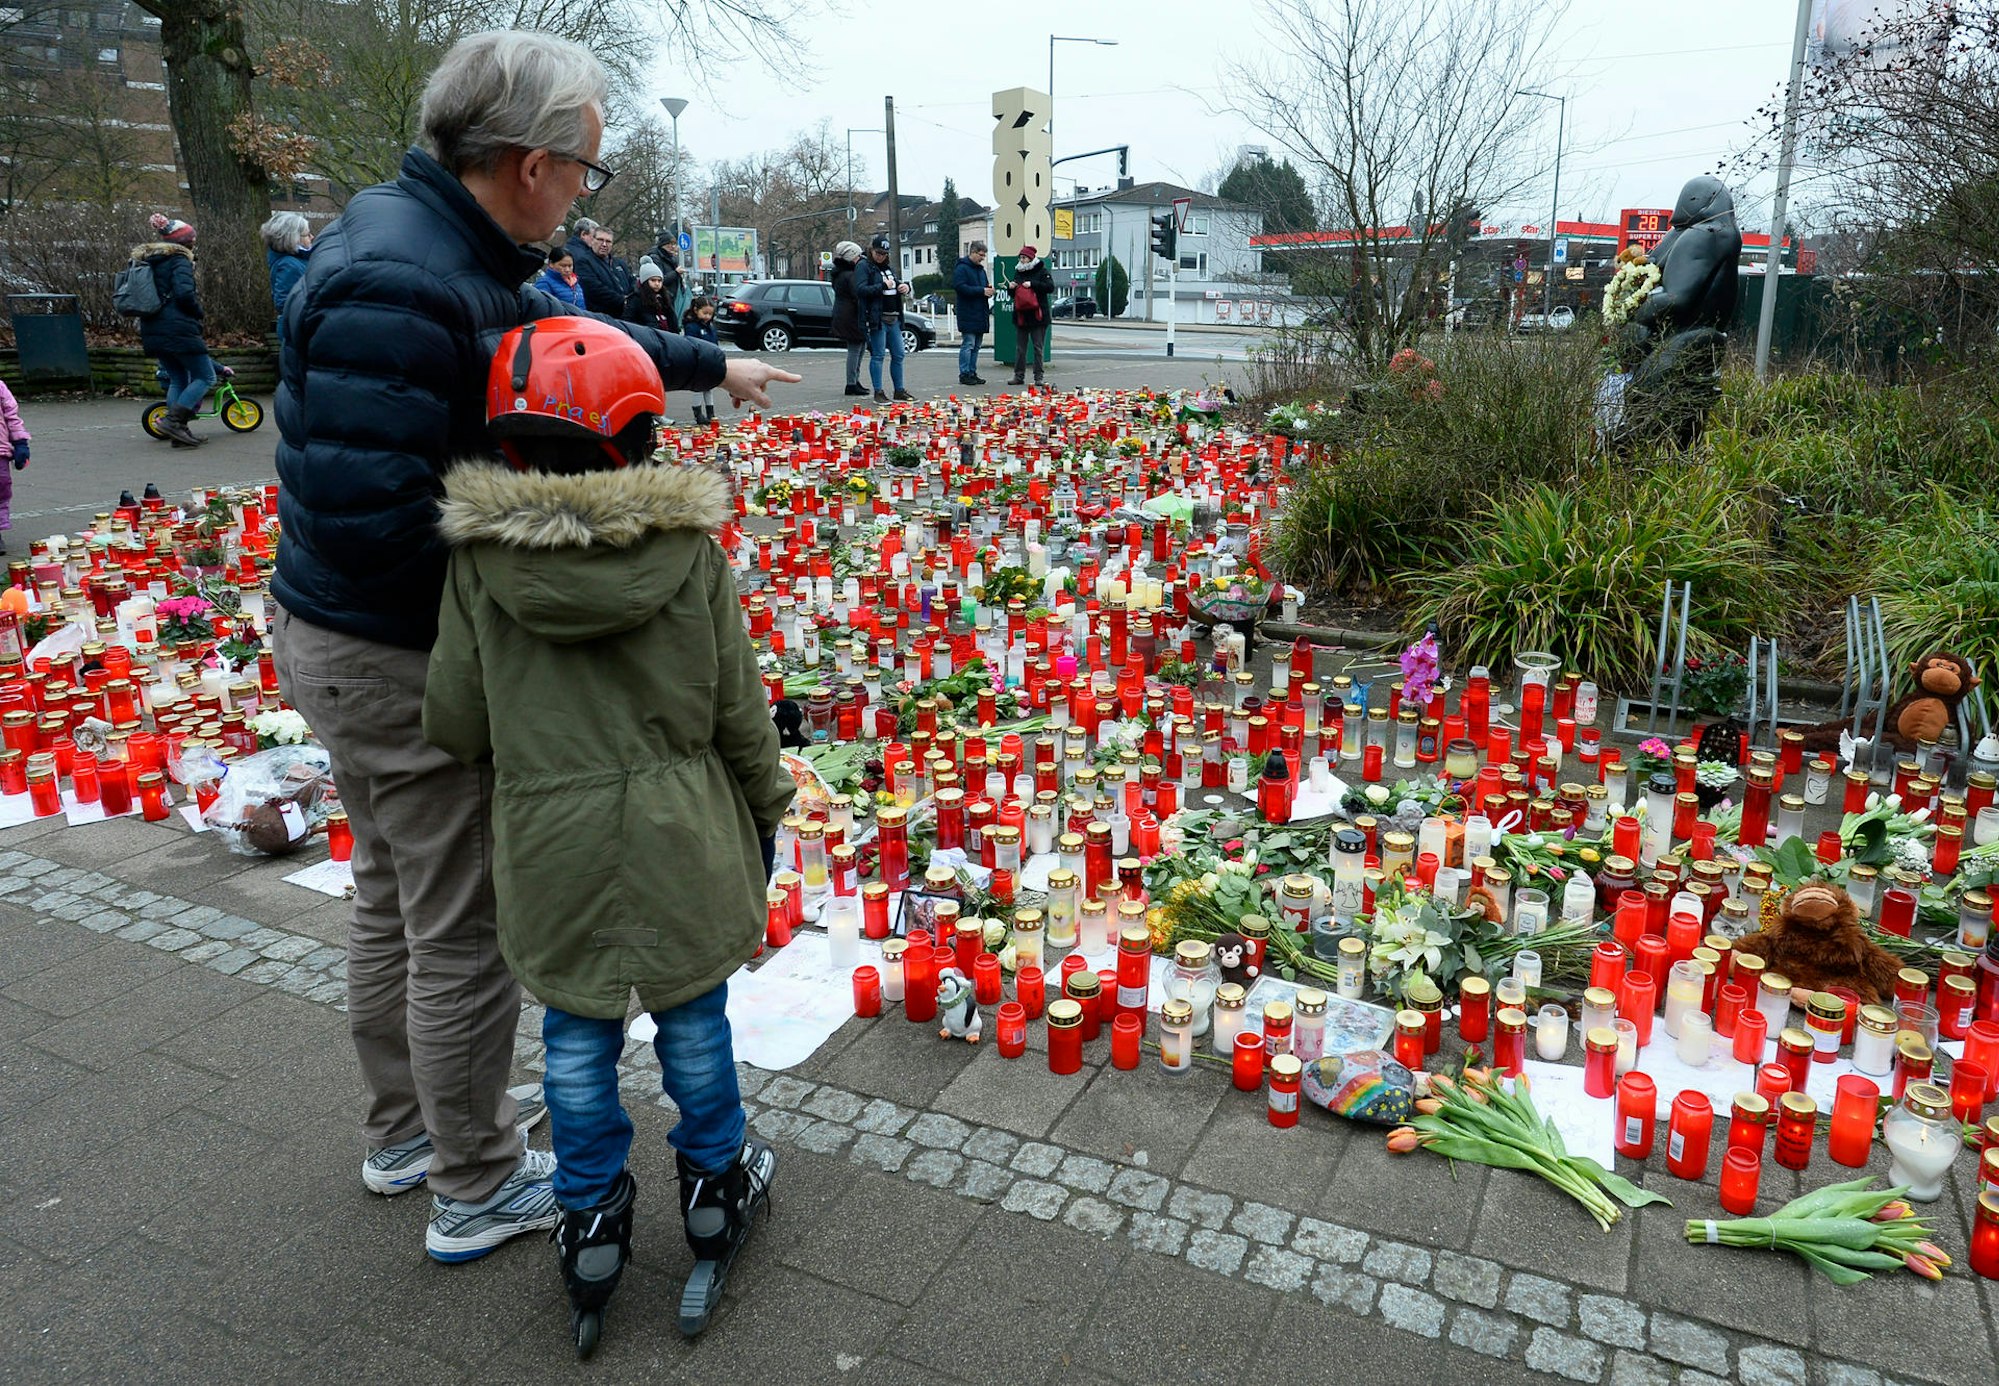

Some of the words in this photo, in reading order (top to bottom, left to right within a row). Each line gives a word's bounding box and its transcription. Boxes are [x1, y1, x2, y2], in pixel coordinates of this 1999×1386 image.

[1638, 215, 1659, 230] 28
[1521, 224, 1540, 234] star
[1628, 233, 1652, 241] SUPER
